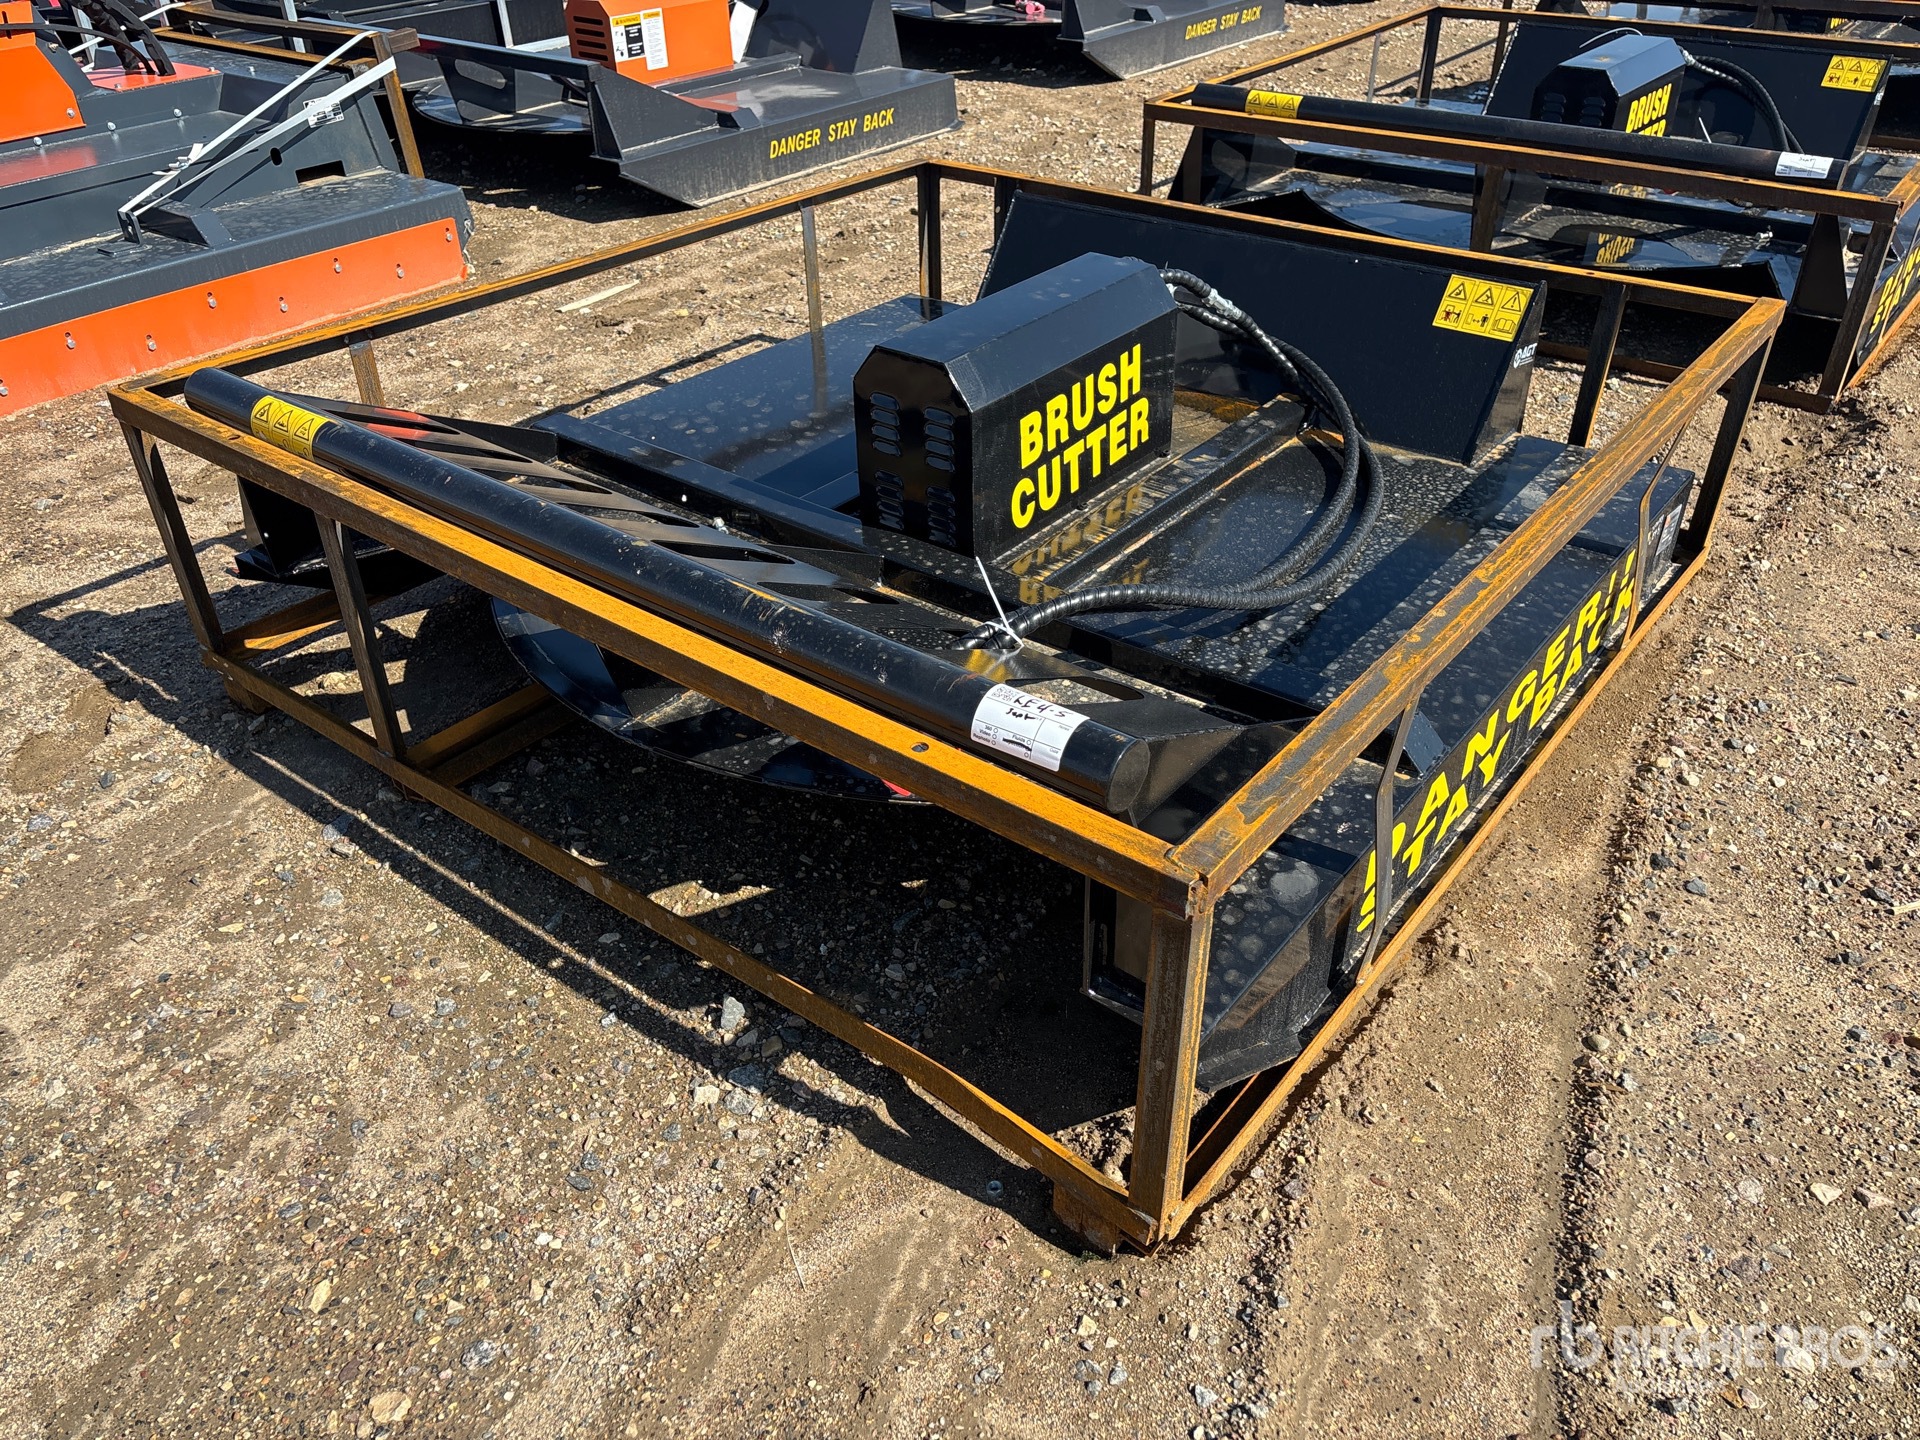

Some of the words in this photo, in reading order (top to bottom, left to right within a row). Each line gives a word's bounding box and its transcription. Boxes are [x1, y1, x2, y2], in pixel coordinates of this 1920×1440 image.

[1185, 18, 1218, 40] DANGER
[1220, 12, 1240, 30] STAY
[1241, 6, 1262, 24] BACK
[770, 128, 821, 159] DANGER
[828, 118, 858, 142] STAY
[863, 108, 895, 132] BACK
[1625, 83, 1672, 134] BRUSH
[1020, 343, 1141, 469] BRUSH
[1011, 397, 1149, 528] CUTTER
[1529, 577, 1636, 731] BACK
